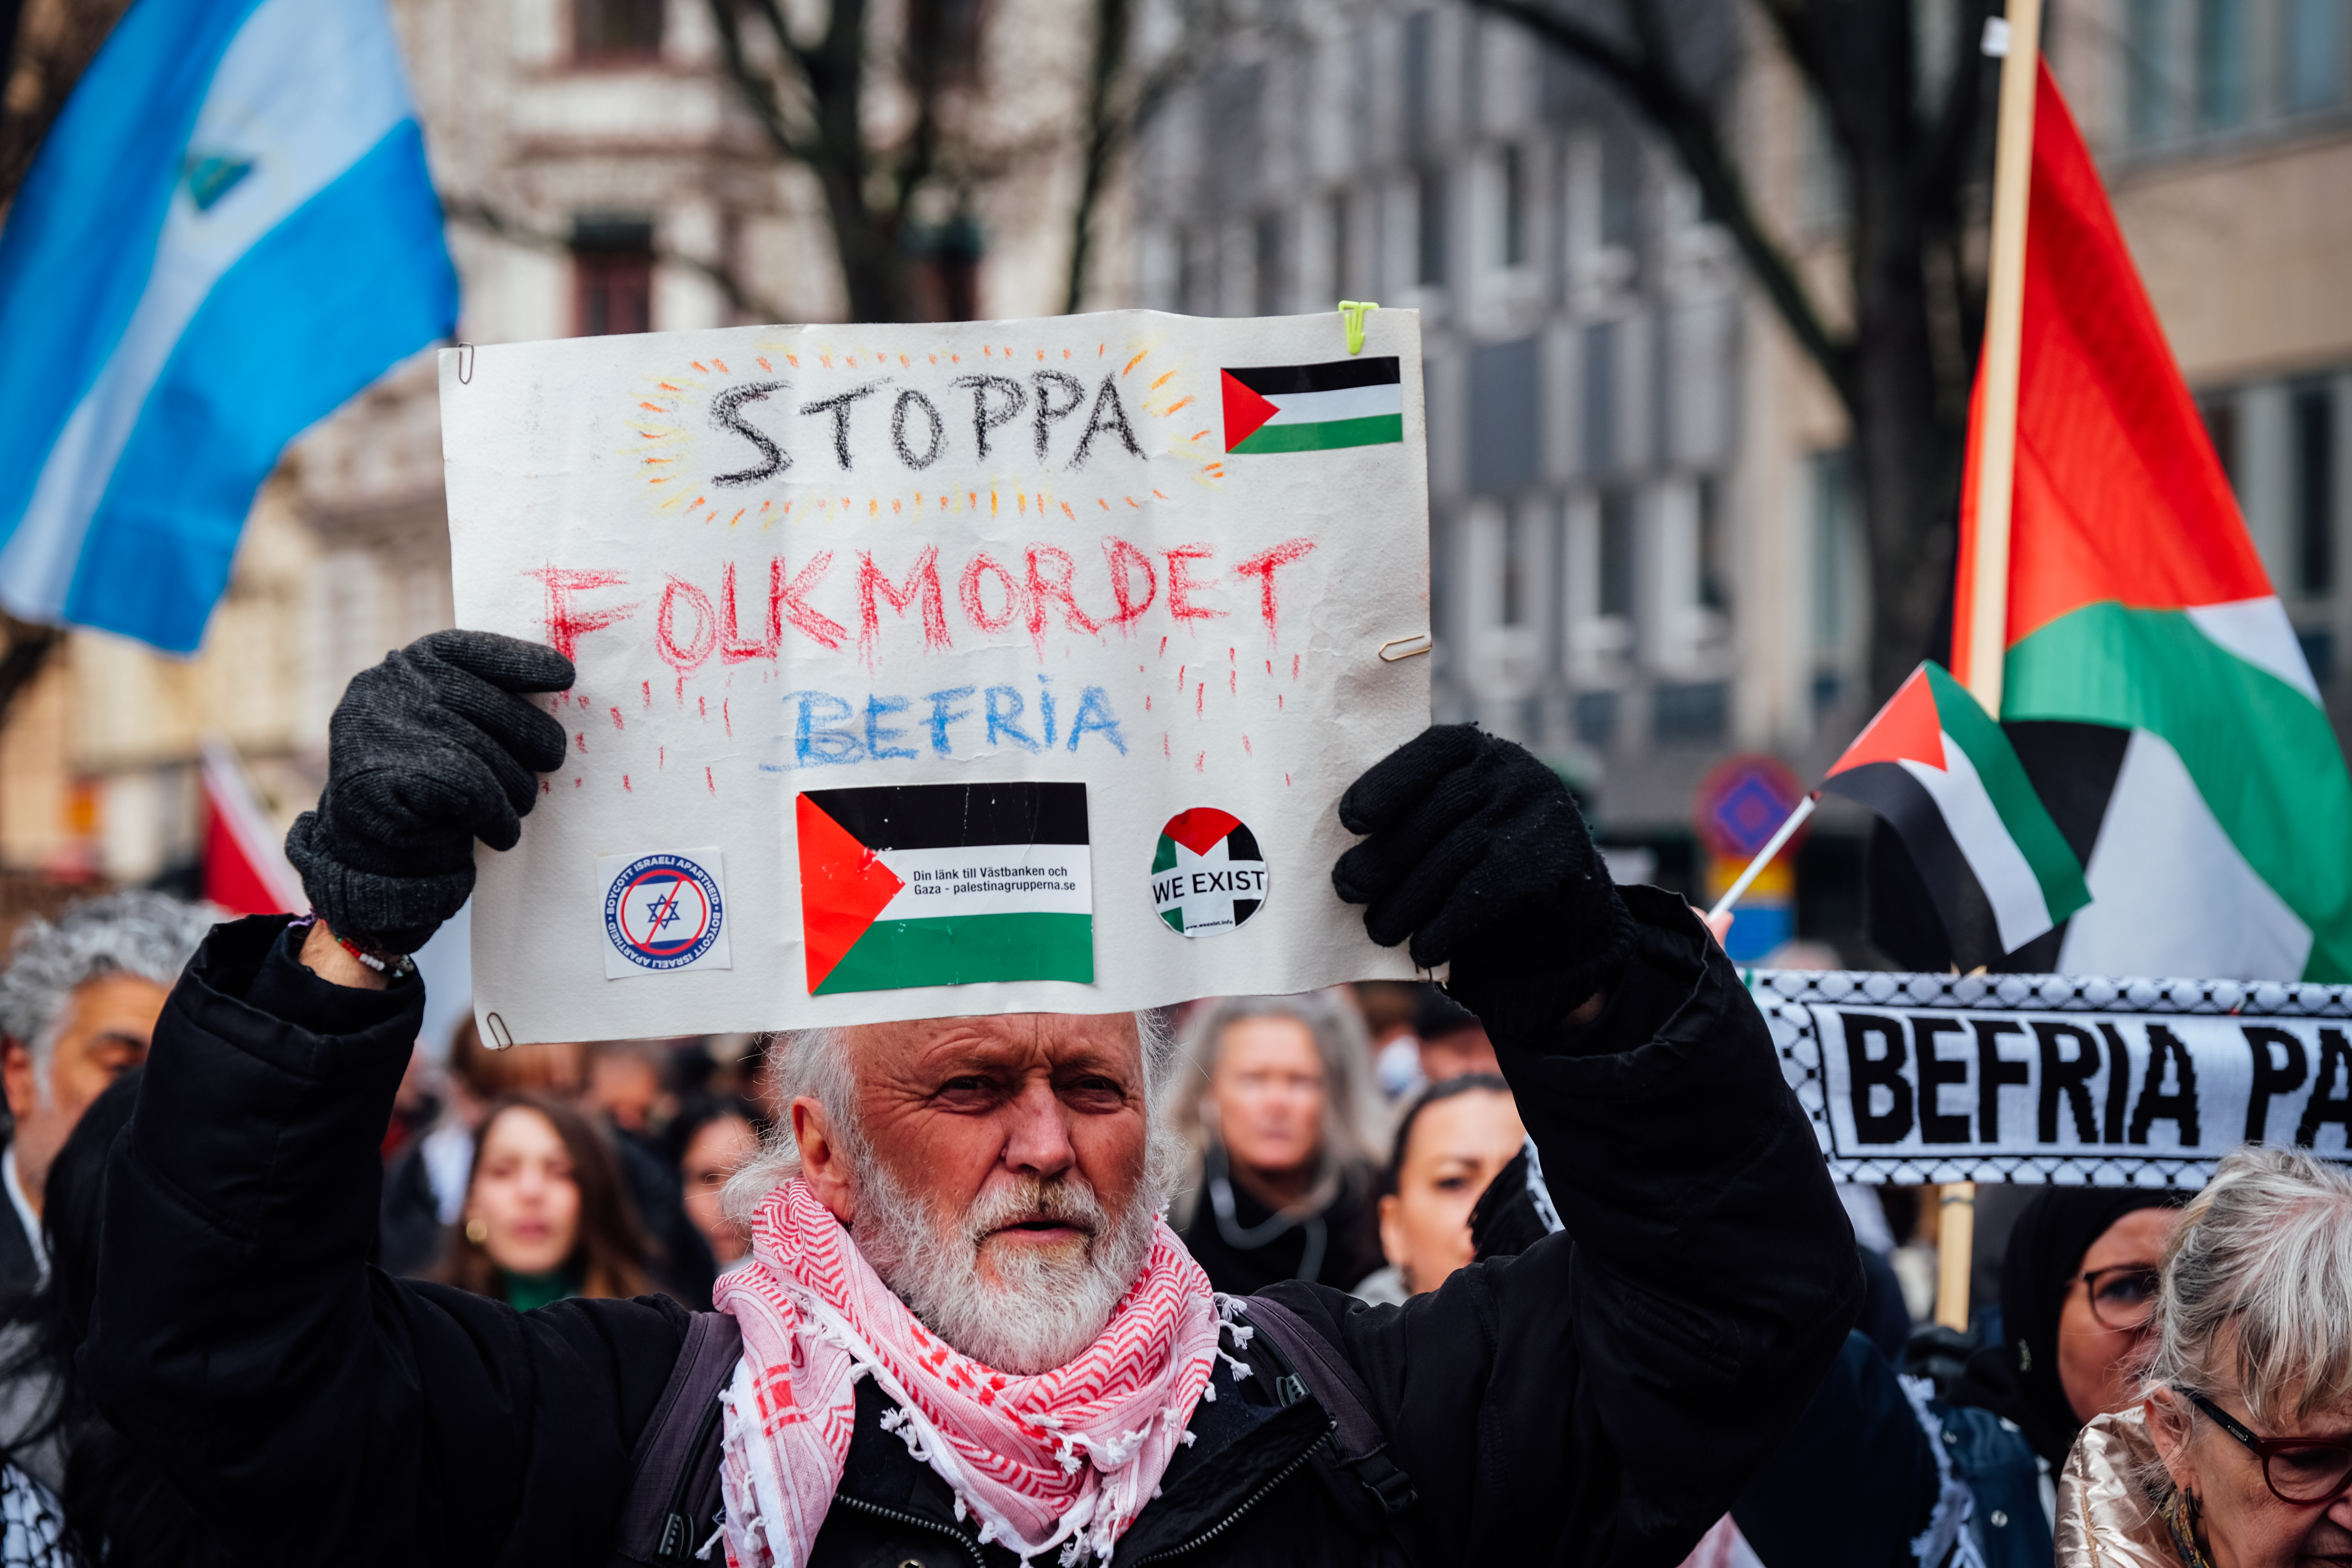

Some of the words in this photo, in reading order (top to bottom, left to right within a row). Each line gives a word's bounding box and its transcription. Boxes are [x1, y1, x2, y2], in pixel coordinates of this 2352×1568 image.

[712, 369, 1148, 487] STOPPA
[523, 534, 1318, 669] FOLKMORDET
[606, 868, 633, 914] BOYCOTT
[634, 856, 674, 871] ISRAELI
[676, 859, 719, 904] APARTHEID
[913, 871, 931, 881] Din
[935, 869, 959, 880] länk
[962, 868, 977, 878] till
[980, 866, 1045, 877] Västbanken
[1048, 866, 1067, 876] och
[914, 885, 941, 895] Gaza
[953, 880, 1076, 895] palestinagrupperna.se
[1152, 876, 1185, 905] WE
[1191, 870, 1265, 894] EXIST
[608, 923, 651, 966] APARTHEID
[694, 913, 721, 957] BOYCOTT
[652, 952, 693, 968] ISRAELI
[1839, 1011, 2201, 1147] BEFRIA
[2240, 1026, 2352, 1148] PA
